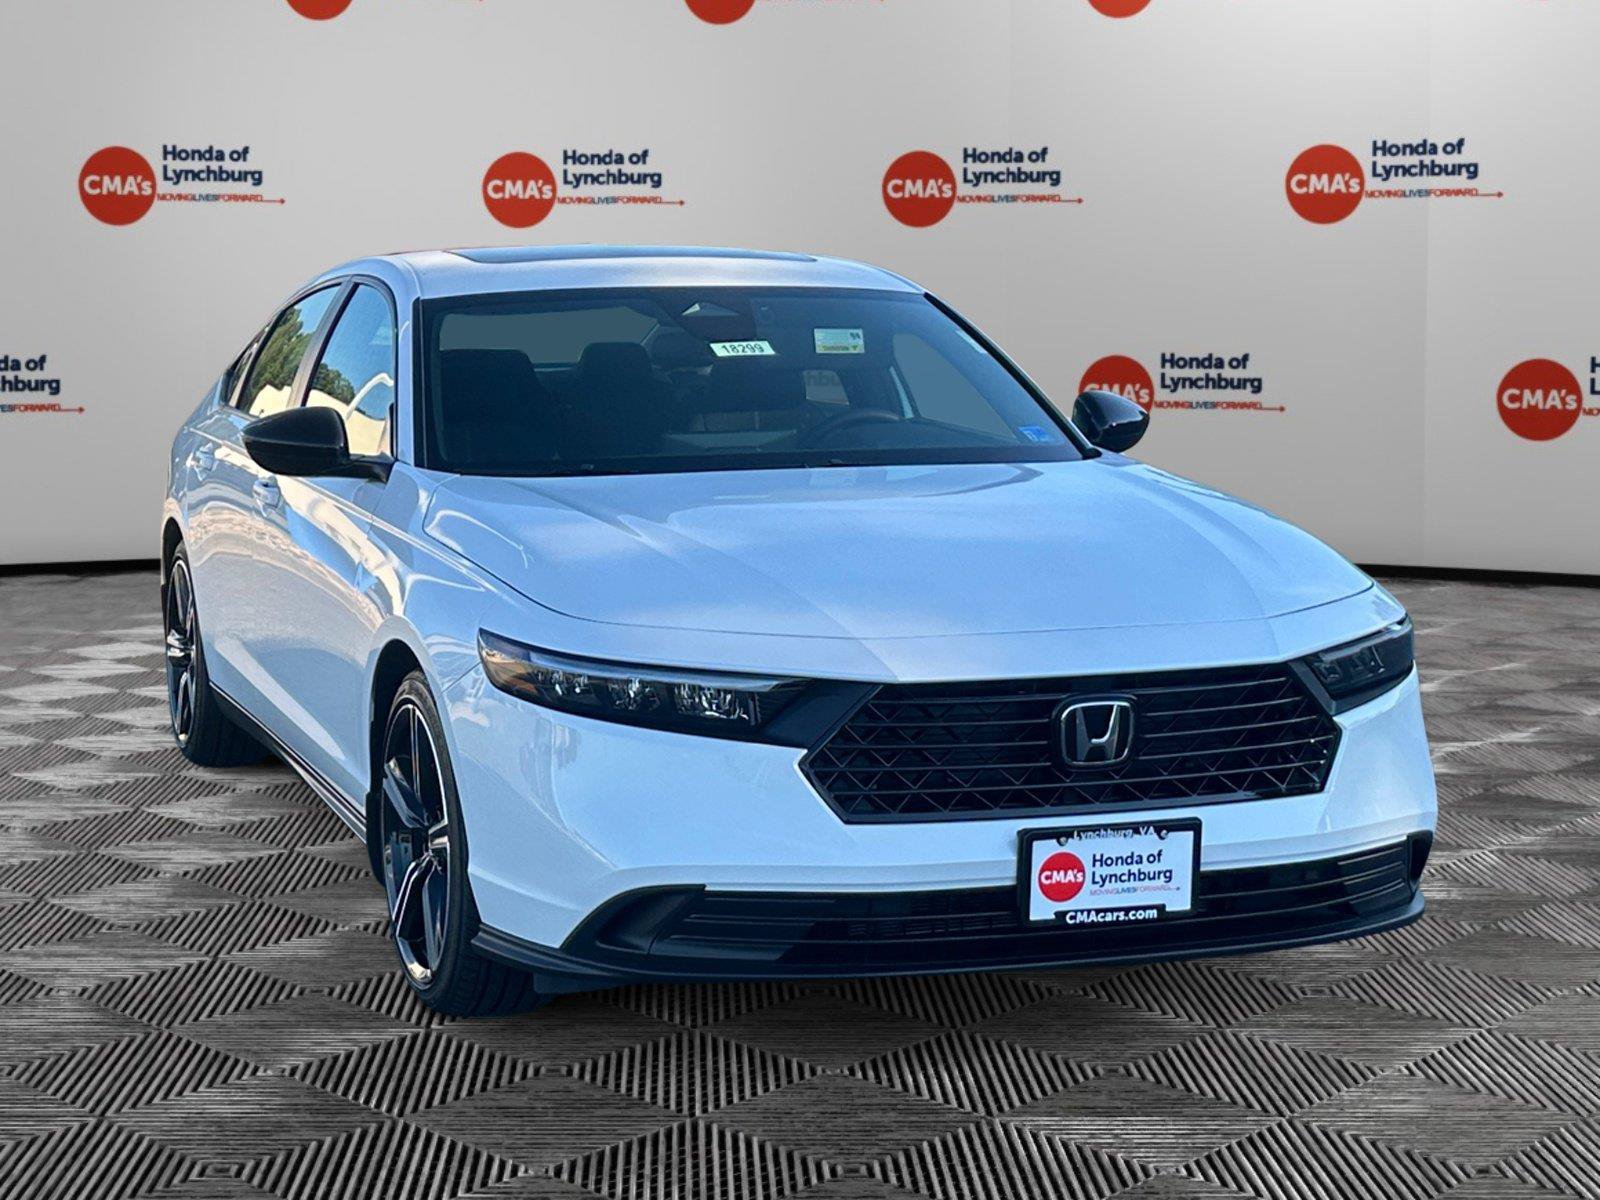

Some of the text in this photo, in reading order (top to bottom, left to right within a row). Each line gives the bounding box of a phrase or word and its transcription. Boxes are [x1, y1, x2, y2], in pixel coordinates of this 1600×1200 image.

[162, 144, 250, 162] Honda of
[562, 148, 650, 166] Honda of
[962, 146, 1049, 164] Honda of
[1371, 137, 1466, 157] Honda of
[162, 164, 263, 186] Lynchburg
[562, 168, 662, 189] Lynchburg
[962, 167, 1061, 187] Lynchburg
[1371, 159, 1479, 181] Lynchburg
[83, 174, 153, 196] CMA's
[486, 178, 553, 200] CMA's
[886, 178, 953, 199] CMA's
[1290, 172, 1361, 195] CMA's
[720, 343, 765, 355] 18299
[24, 354, 47, 371] of
[1160, 352, 1250, 370] Honda of
[0, 374, 61, 396] hburg
[1160, 372, 1263, 394] Lynchburg
[1501, 388, 1578, 410] CMA's
[1139, 825, 1155, 836] VA
[1091, 849, 1163, 868] Honda of
[1040, 869, 1084, 885] CMA's
[1091, 867, 1173, 888] Lynchburg
[1065, 908, 1158, 924] CMAcars.com
